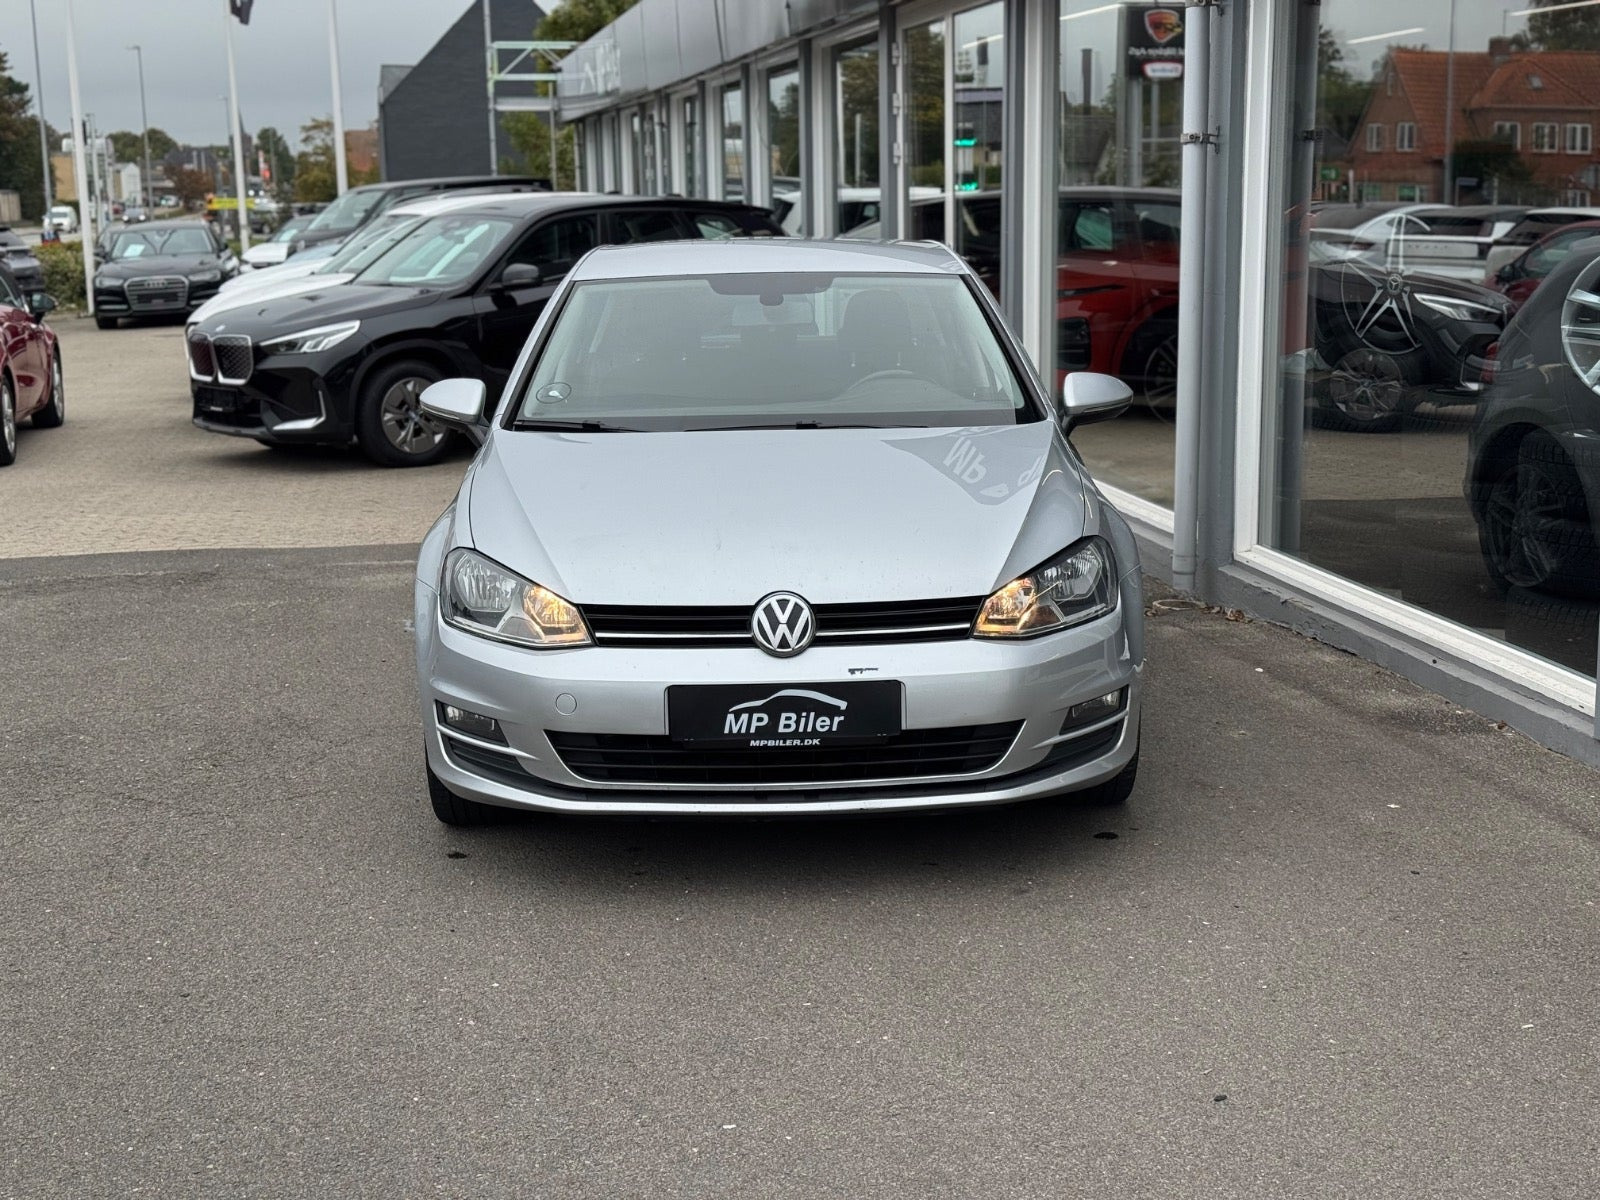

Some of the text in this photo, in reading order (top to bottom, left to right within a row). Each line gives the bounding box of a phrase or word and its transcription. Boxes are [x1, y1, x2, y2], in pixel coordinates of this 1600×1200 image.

[755, 595, 811, 652] VW
[724, 712, 845, 734] MP Biler
[750, 738, 821, 747] MPBILER.DK
